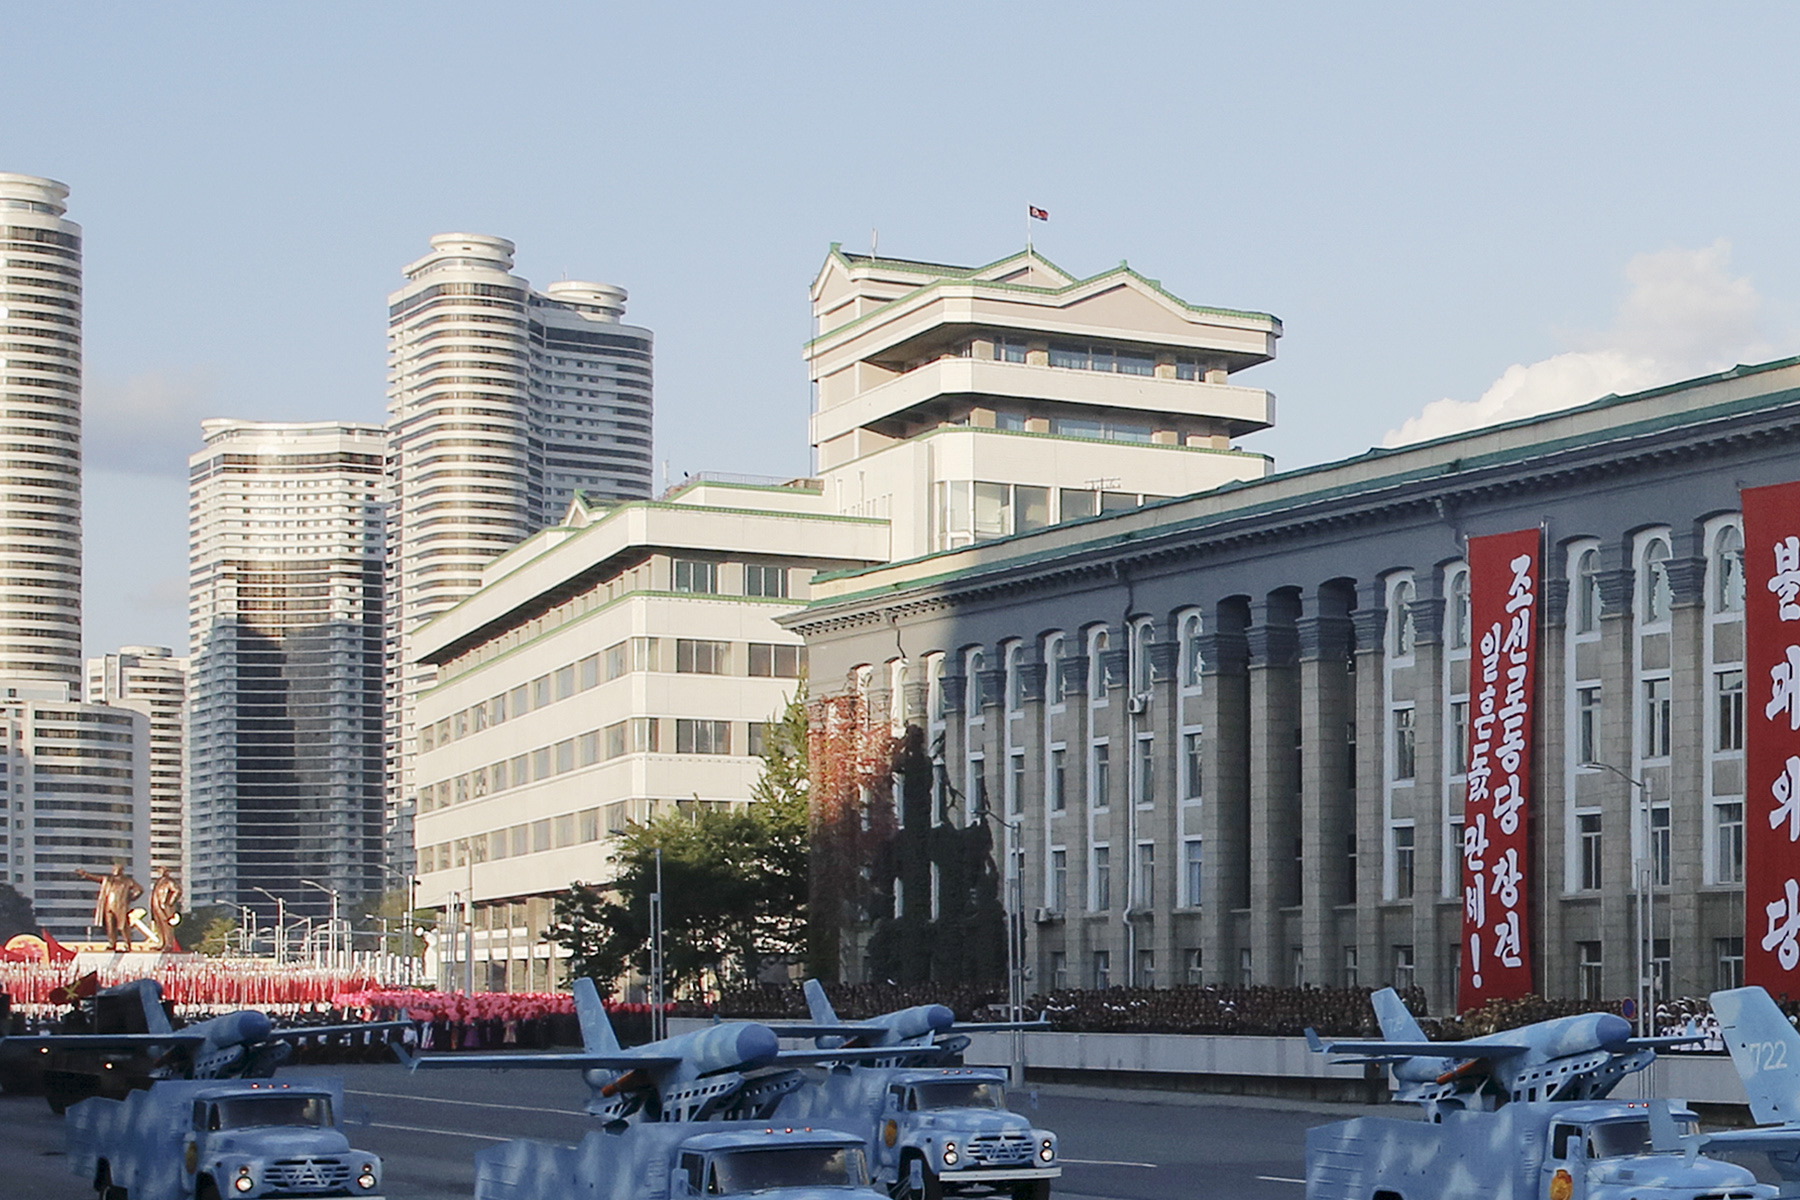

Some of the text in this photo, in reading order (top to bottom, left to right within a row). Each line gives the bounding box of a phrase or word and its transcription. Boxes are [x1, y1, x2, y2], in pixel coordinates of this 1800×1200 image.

[1464, 621, 1502, 990] 일흔돐 만세!
[1490, 553, 1535, 968] 조선로동당 창건
[1749, 1041, 1788, 1072] 722
